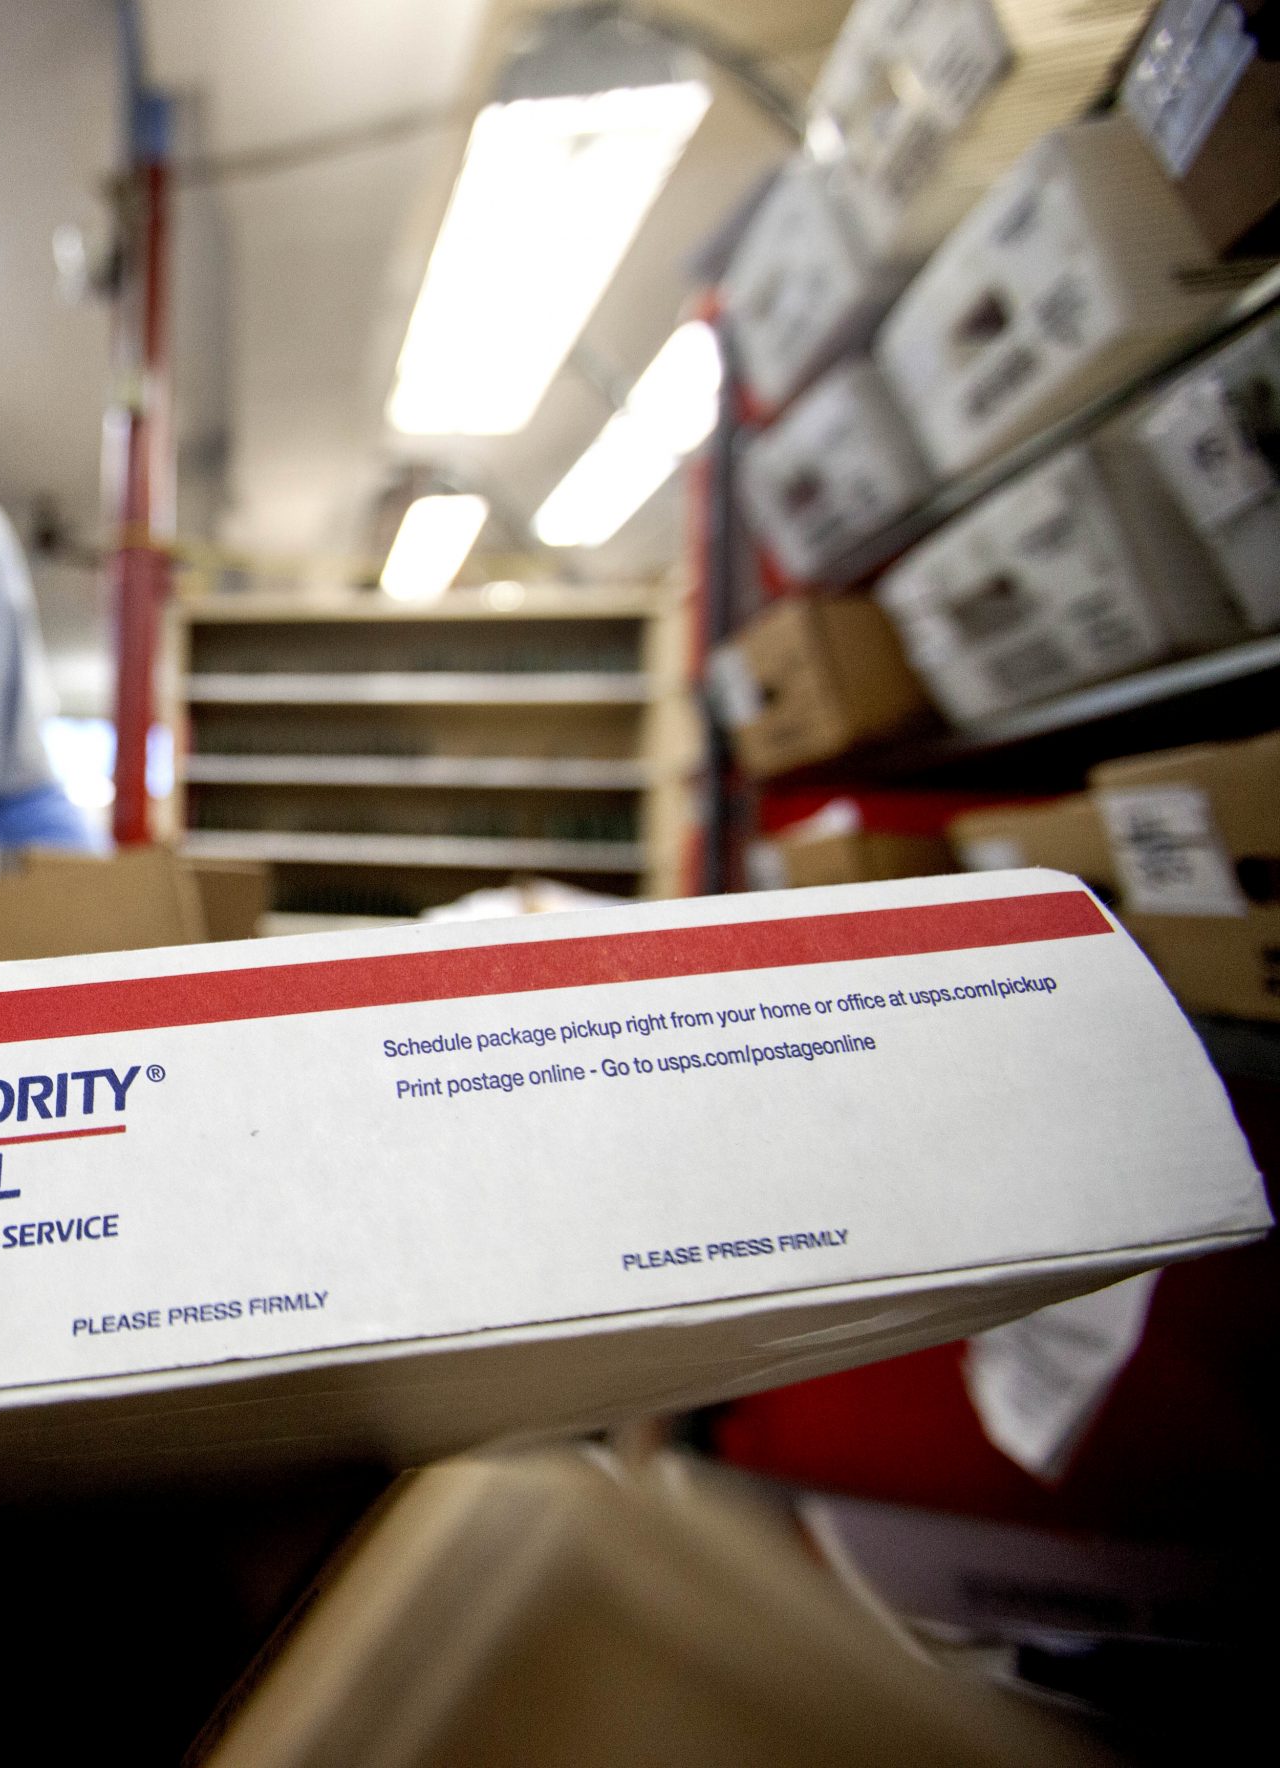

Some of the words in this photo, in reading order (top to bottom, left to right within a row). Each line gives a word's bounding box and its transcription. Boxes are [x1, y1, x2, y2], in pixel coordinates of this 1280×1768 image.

[382, 1032, 473, 1058] Schedule
[476, 1026, 557, 1052] package
[559, 1018, 622, 1045] pickup
[625, 1013, 669, 1037] right
[669, 1009, 715, 1029] from
[715, 1008, 757, 1029] your
[758, 1001, 813, 1021] home
[813, 999, 834, 1015] or
[836, 992, 887, 1013] office
[887, 989, 909, 1008] at
[908, 974, 1059, 1007] usps.com/pickup
[395, 1076, 444, 1100] Print
[446, 1071, 526, 1099] postage
[528, 1063, 587, 1086] online
[600, 1057, 631, 1078] Go
[632, 1056, 655, 1075] to
[656, 1033, 878, 1075] usps.com/postageonline
[1, 1213, 120, 1250] SERVICE
[621, 1244, 704, 1272] PLEASE
[705, 1236, 776, 1262] PRESS
[777, 1228, 851, 1253] FIRMLY
[71, 1309, 162, 1338] PLEASE
[167, 1300, 244, 1327] PRESS
[247, 1290, 330, 1317] FIRMLY
